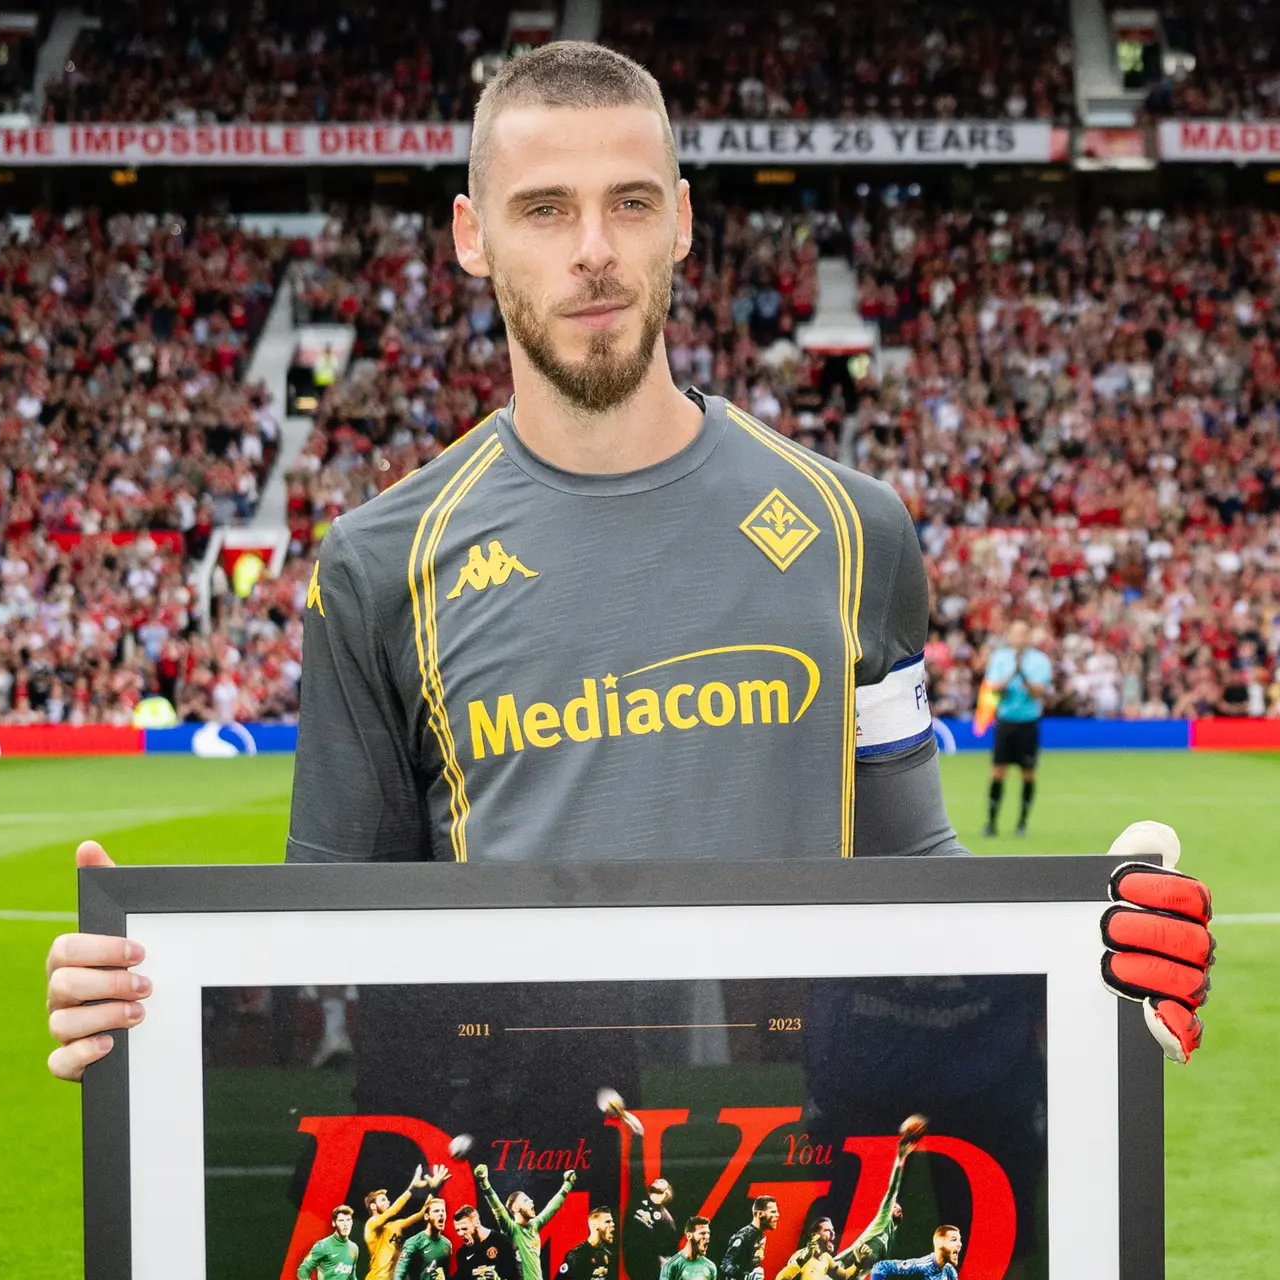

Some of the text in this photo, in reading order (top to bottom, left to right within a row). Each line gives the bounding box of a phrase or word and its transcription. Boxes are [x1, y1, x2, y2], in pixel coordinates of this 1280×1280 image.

[70, 126, 305, 155] IMPOSSIBLE
[320, 126, 454, 154] DREAM
[720, 126, 816, 153] ALEX
[832, 126, 874, 153] 26
[887, 126, 1016, 153] YEARS
[468, 672, 790, 760] Mediacom
[458, 1017, 802, 1037] 2011 2023
[491, 1133, 833, 1172] Thank You
